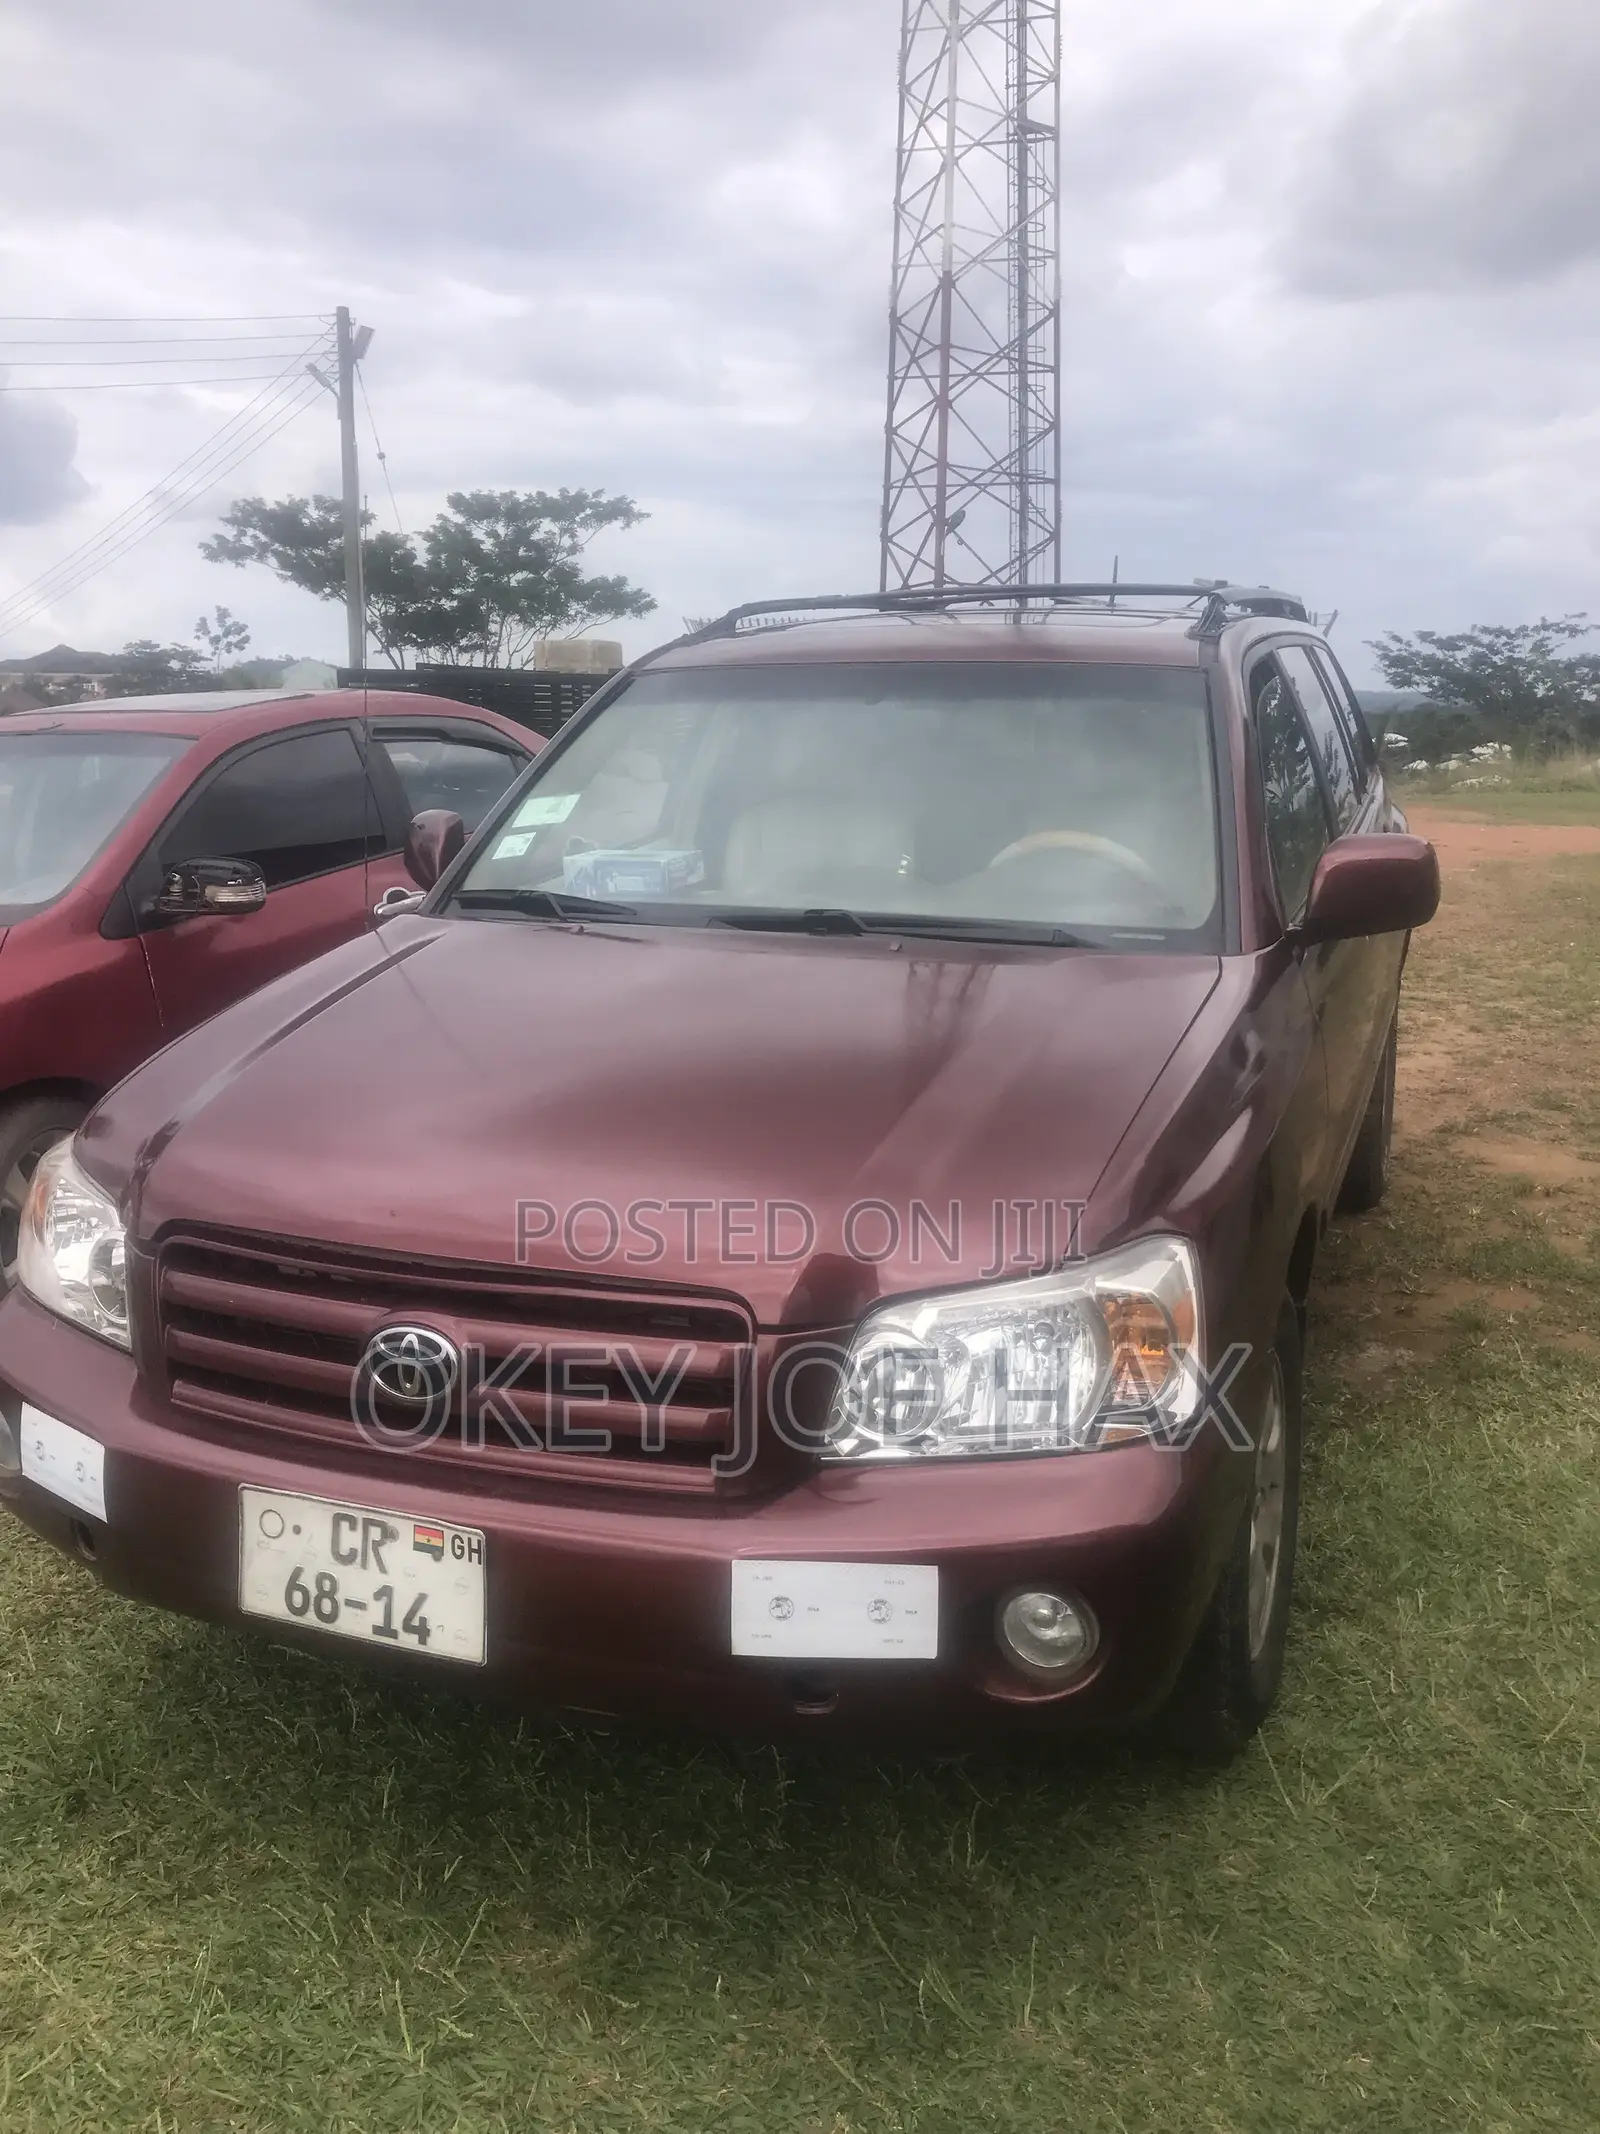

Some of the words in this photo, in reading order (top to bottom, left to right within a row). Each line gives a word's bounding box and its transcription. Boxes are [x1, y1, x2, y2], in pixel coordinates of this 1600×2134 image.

[331, 1511, 388, 1575] CR
[450, 1533, 483, 1566] GH
[284, 1564, 431, 1646] 68-14
